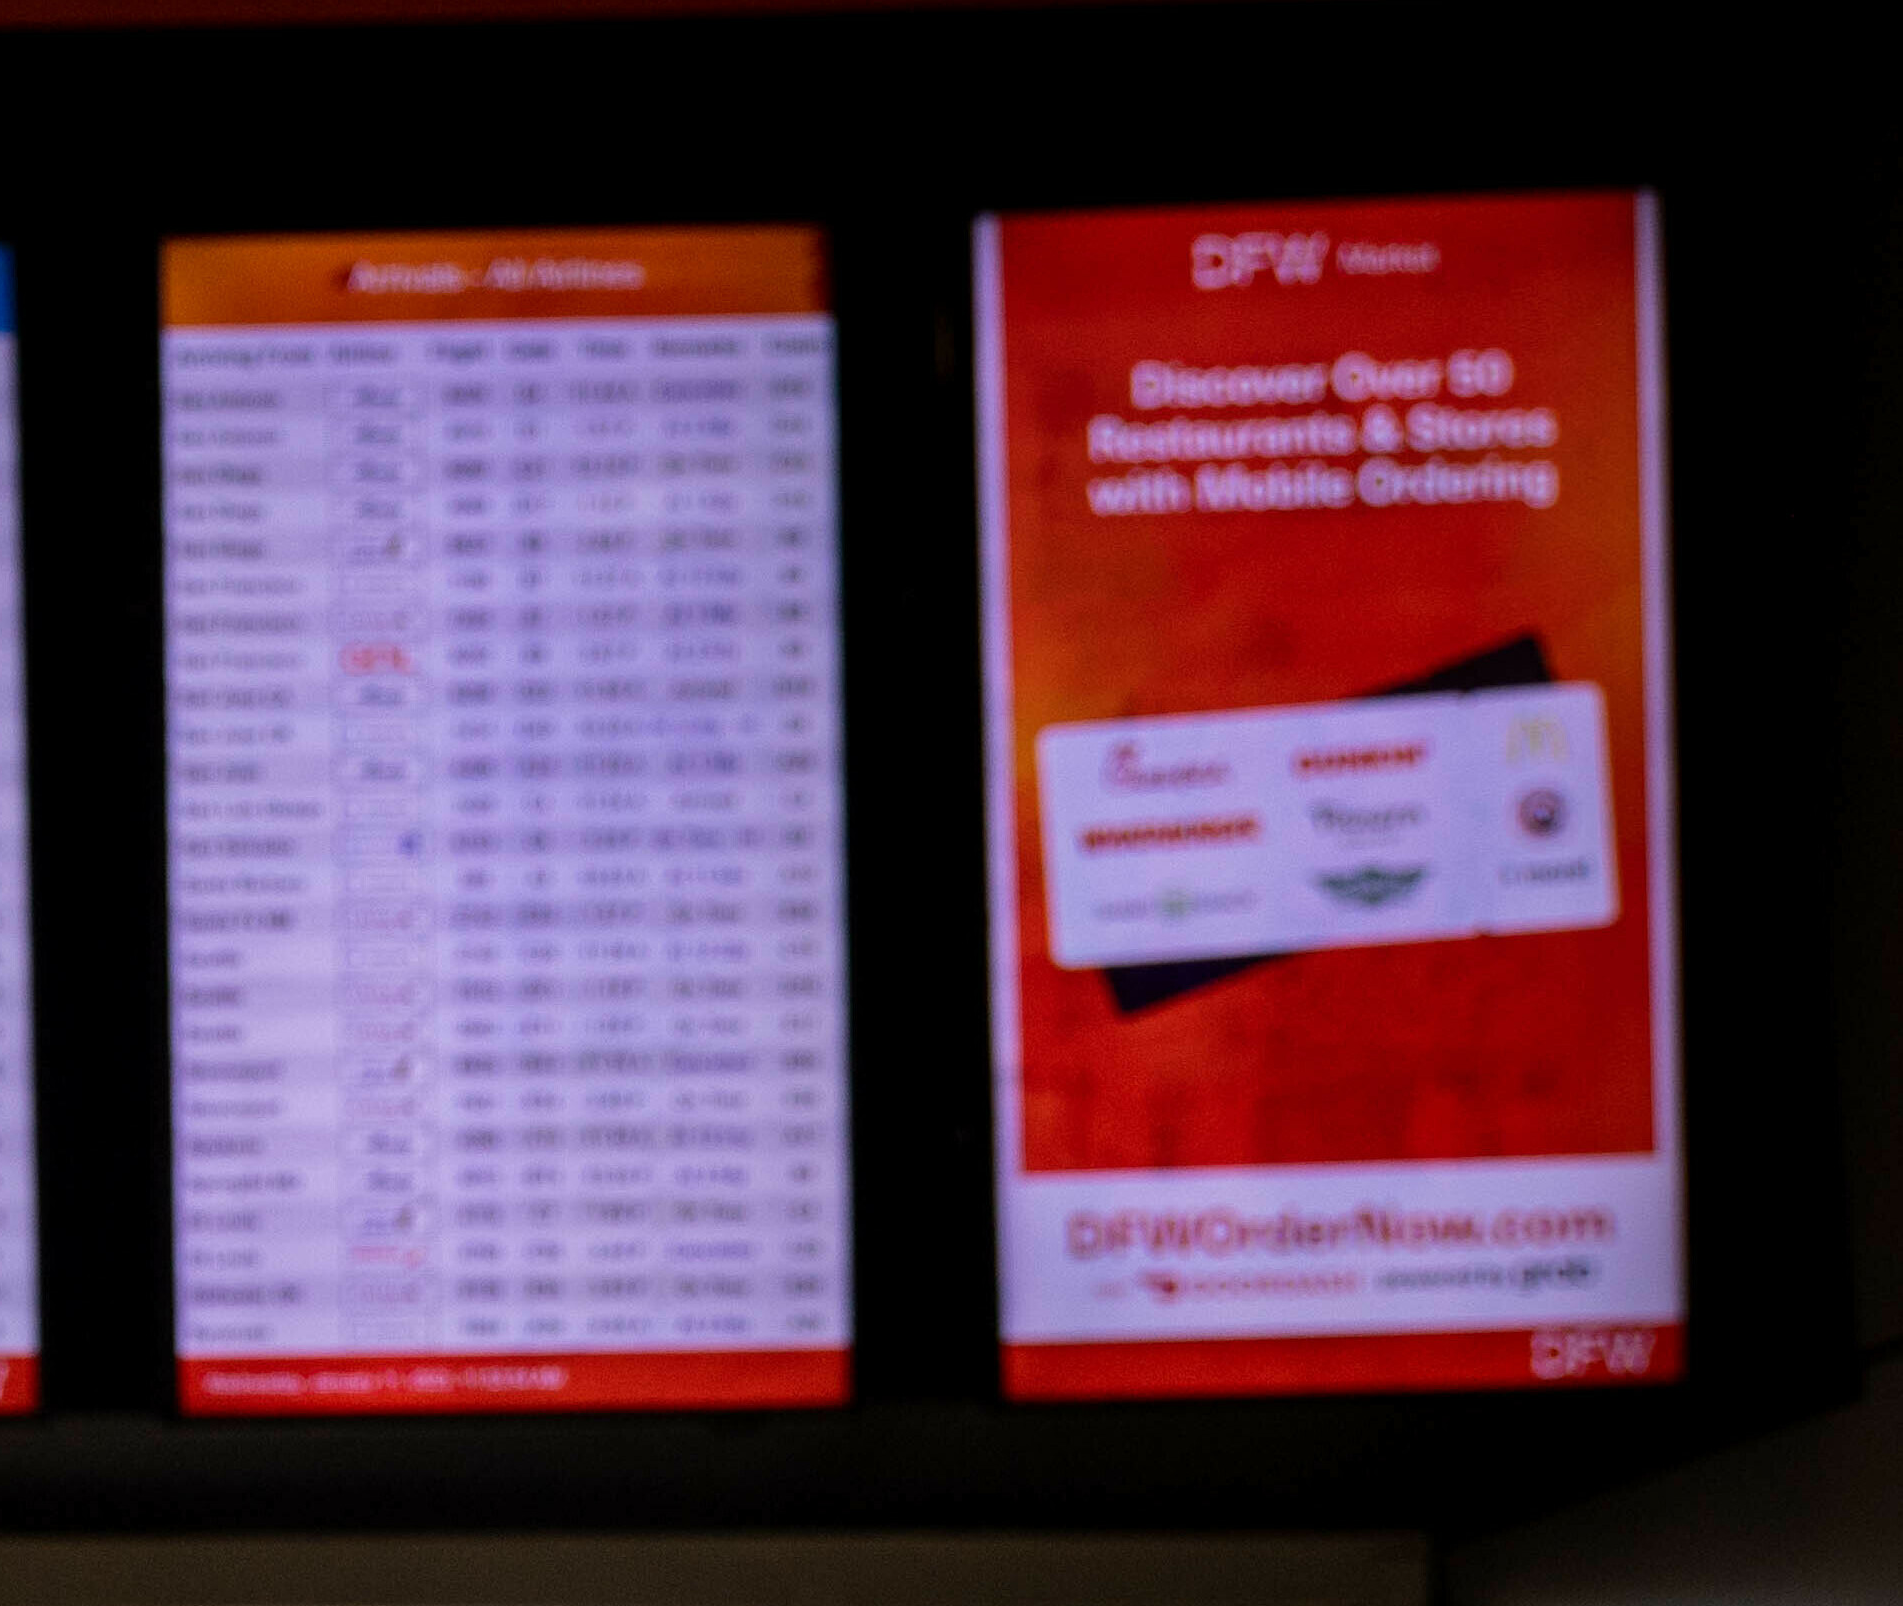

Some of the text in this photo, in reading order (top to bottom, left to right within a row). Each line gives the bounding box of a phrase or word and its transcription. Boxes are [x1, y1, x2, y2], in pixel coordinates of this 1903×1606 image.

[1195, 234, 1326, 286] DFW
[1135, 363, 1326, 406] Discover
[1334, 355, 1439, 399] Over
[1090, 405, 1555, 461] Restaurants & Stores
[1092, 459, 1555, 514] with Mobile Ordering
[1070, 1207, 1614, 1257] DFWOrderNow.com
[1532, 1331, 1656, 1377] DFW
